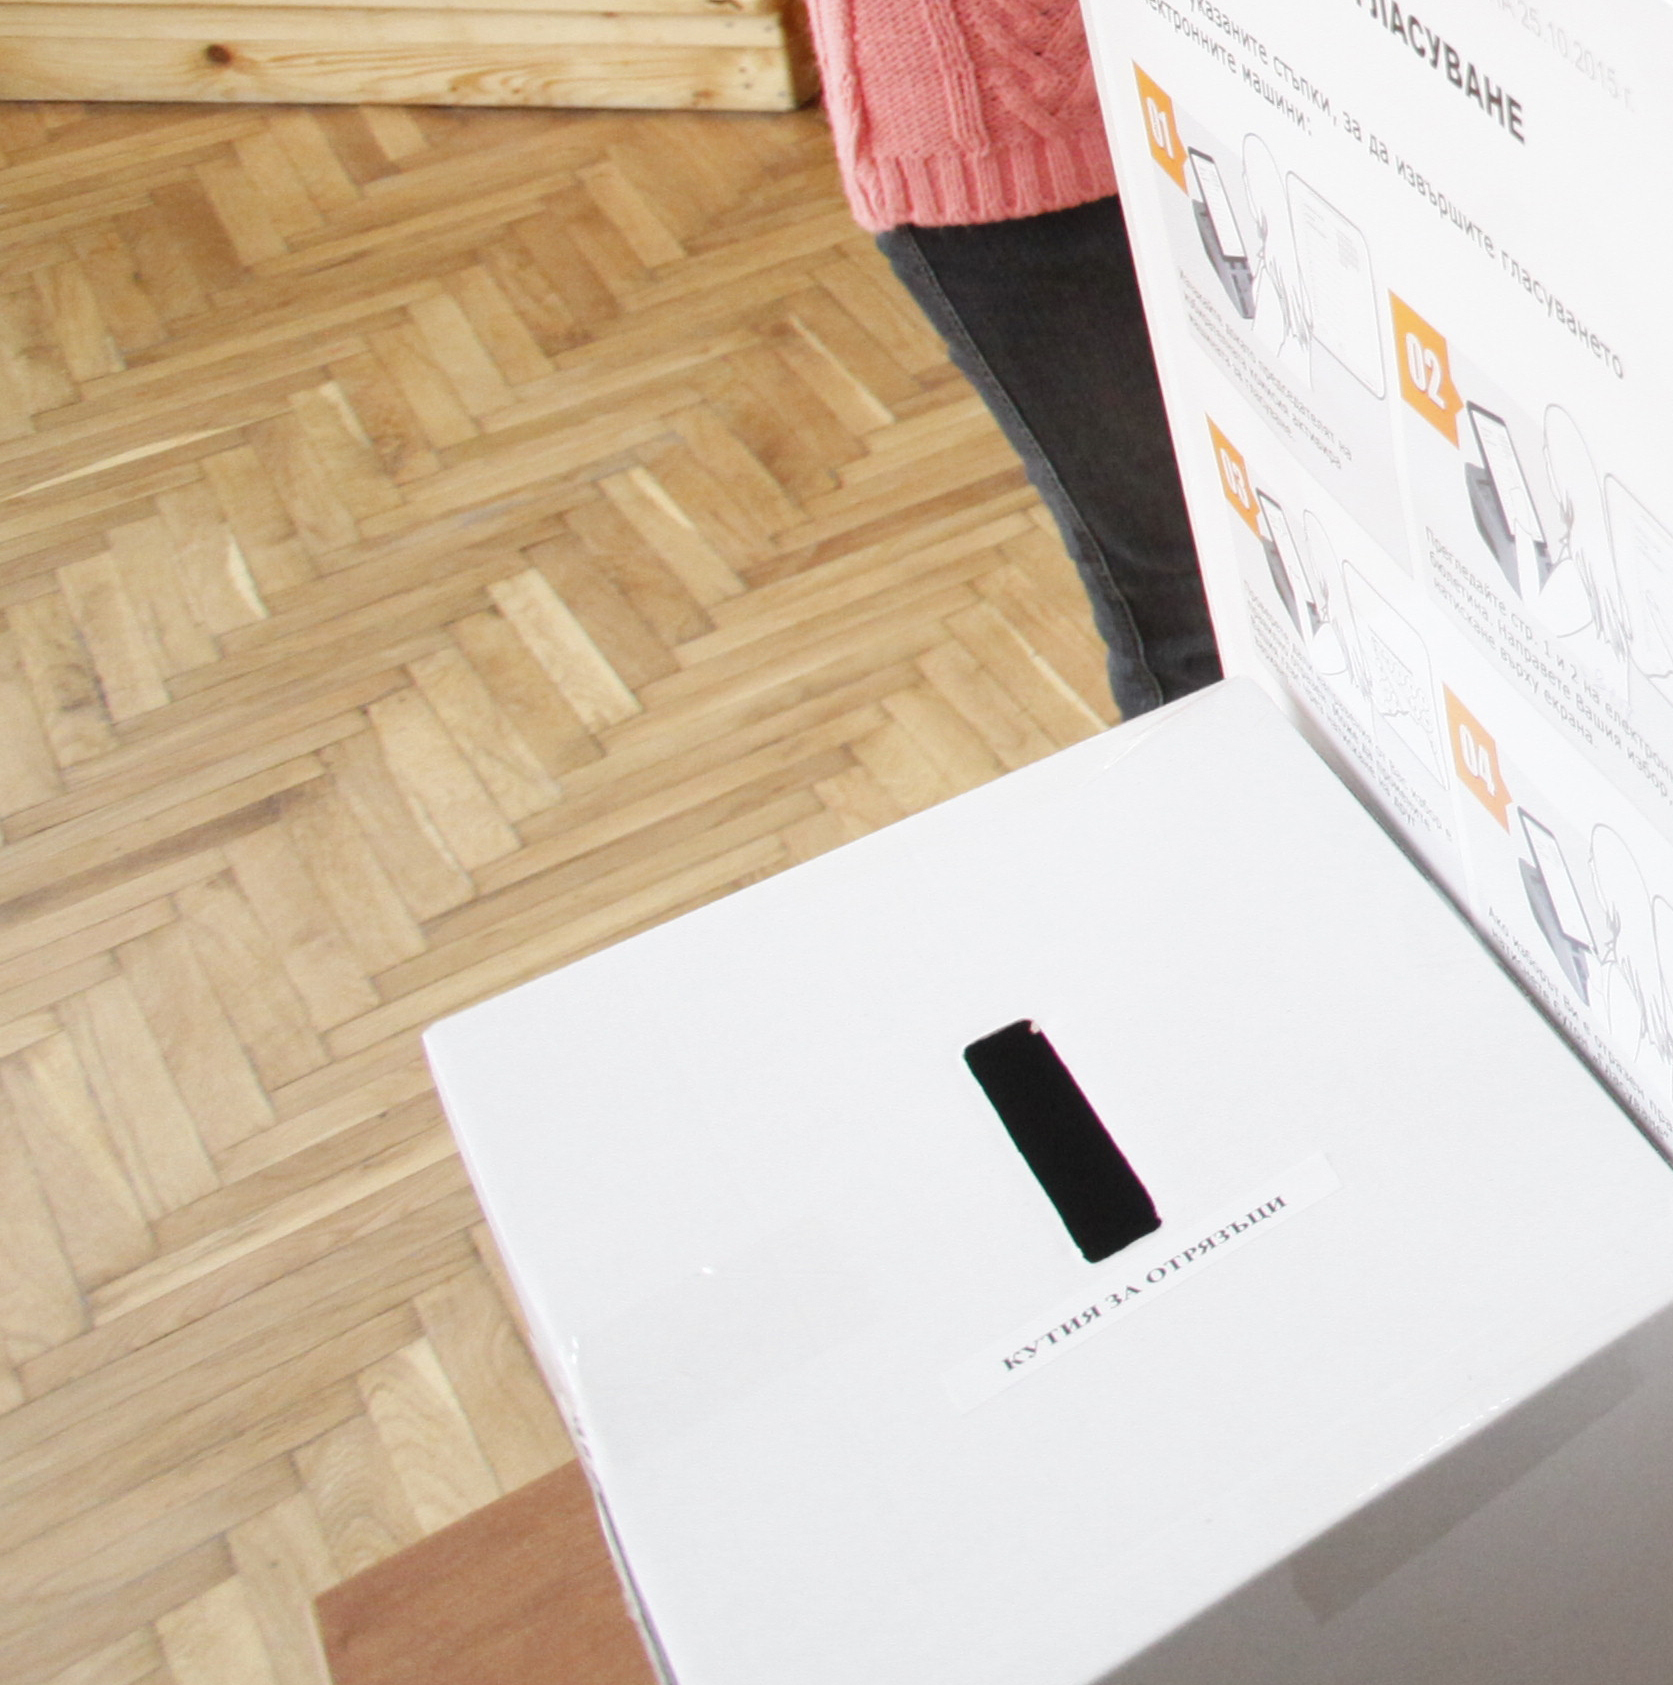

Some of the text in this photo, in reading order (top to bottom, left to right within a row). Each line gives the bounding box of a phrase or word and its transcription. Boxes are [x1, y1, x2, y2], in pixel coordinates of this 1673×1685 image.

[1146, 96, 1175, 160] 01
[1242, 63, 1313, 137] машини:
[1342, 111, 1362, 142] за
[1369, 134, 1389, 165] да
[1395, 155, 1495, 259] извършите
[1501, 249, 1624, 380] гласуването
[1405, 331, 1446, 410] 02
[1219, 447, 1251, 511] 03
[1425, 525, 1506, 617] Прегледайте
[1584, 681, 1600, 705] на
[1498, 618, 1571, 700] Направете
[1575, 693, 1622, 750] Вашия
[1500, 646, 1539, 694] върху
[1459, 723, 1495, 797] 04
[1002, 1195, 1287, 1372] КУТИЯ ЗА ОТРЯЗЪЦИ
